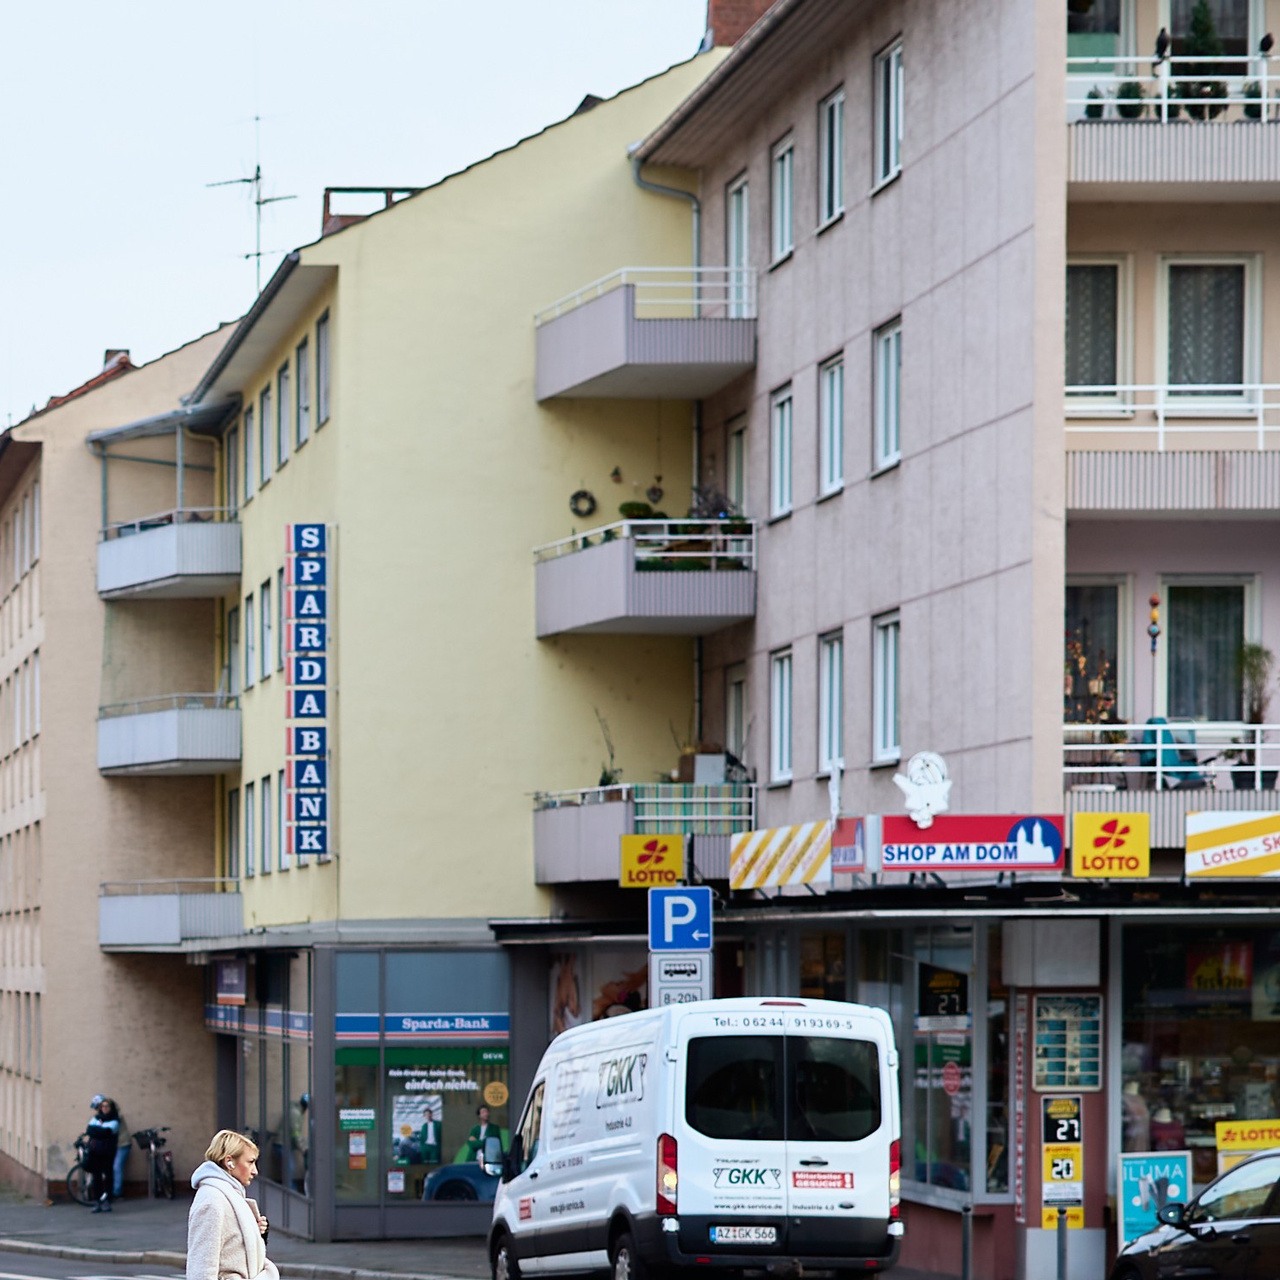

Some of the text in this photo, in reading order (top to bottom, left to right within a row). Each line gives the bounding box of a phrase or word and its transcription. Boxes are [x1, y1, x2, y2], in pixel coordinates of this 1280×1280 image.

[299, 527, 323, 850] SPARDA BANK
[883, 844, 1019, 861] SHOP AM DOM
[1201, 846, 1249, 867] Lotto
[1082, 856, 1140, 870] LOTTO
[628, 869, 676, 883] LOTTO
[664, 896, 697, 943] P
[402, 1018, 490, 1031] Sparda-Bank
[713, 1017, 738, 1028] Tel.:
[606, 1053, 638, 1097] GKK
[404, 1078, 480, 1091] einfach nichts.
[1056, 1119, 1080, 1140] 27
[1240, 1126, 1280, 1141] LOTTO
[728, 1168, 768, 1185] GKK
[1051, 1158, 1074, 1180] 20
[1123, 1164, 1184, 1181] ILUMA
[714, 1202, 783, 1211] www.gkk-service.de
[717, 1228, 775, 1240] AZ GK 566
